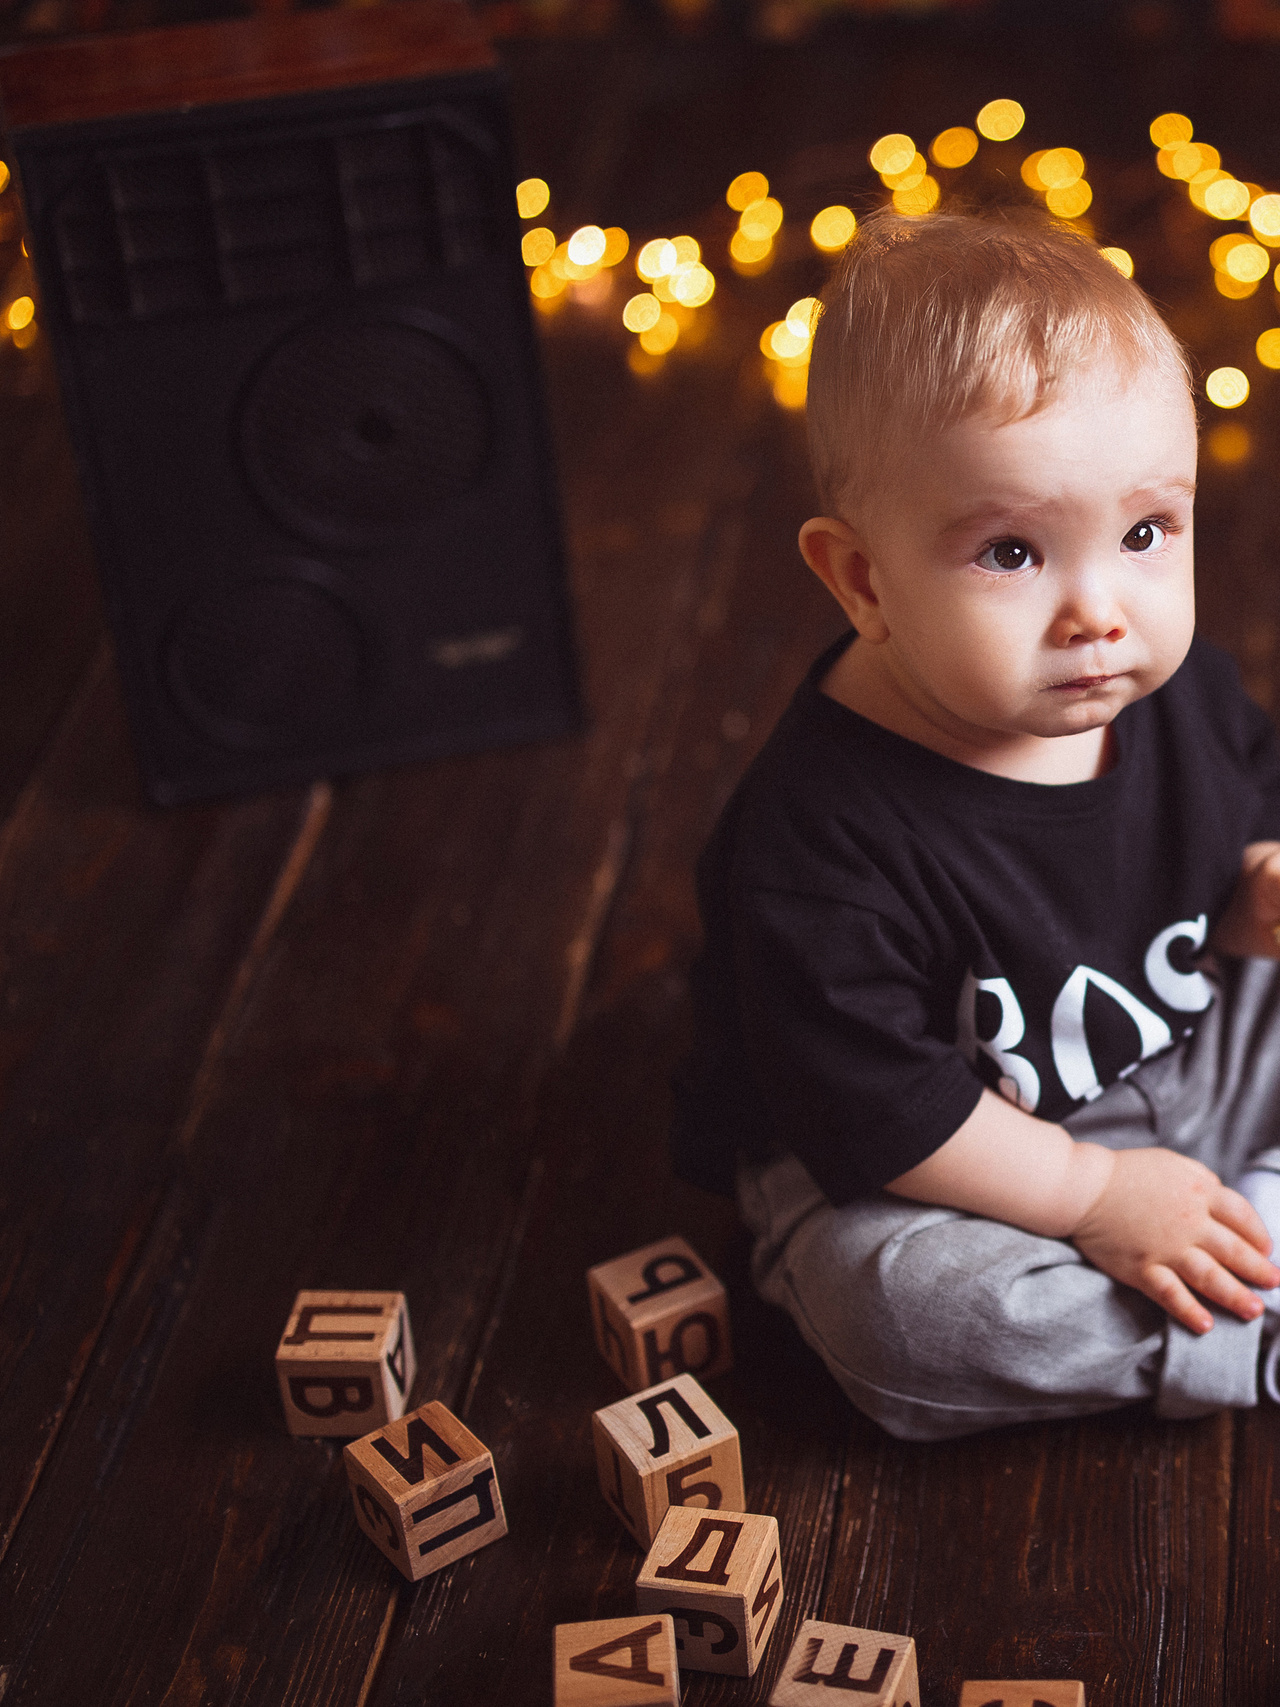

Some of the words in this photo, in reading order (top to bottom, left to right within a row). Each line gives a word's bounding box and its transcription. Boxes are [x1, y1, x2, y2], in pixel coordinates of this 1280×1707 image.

[284, 1306, 384, 1346] Ц
[643, 1311, 722, 1384] Ю
[287, 1376, 375, 1418] В
[636, 1388, 712, 1458] Л
[411, 1467, 495, 1556] Ц
[655, 1518, 744, 1586] Д
[570, 1621, 664, 1687] А
